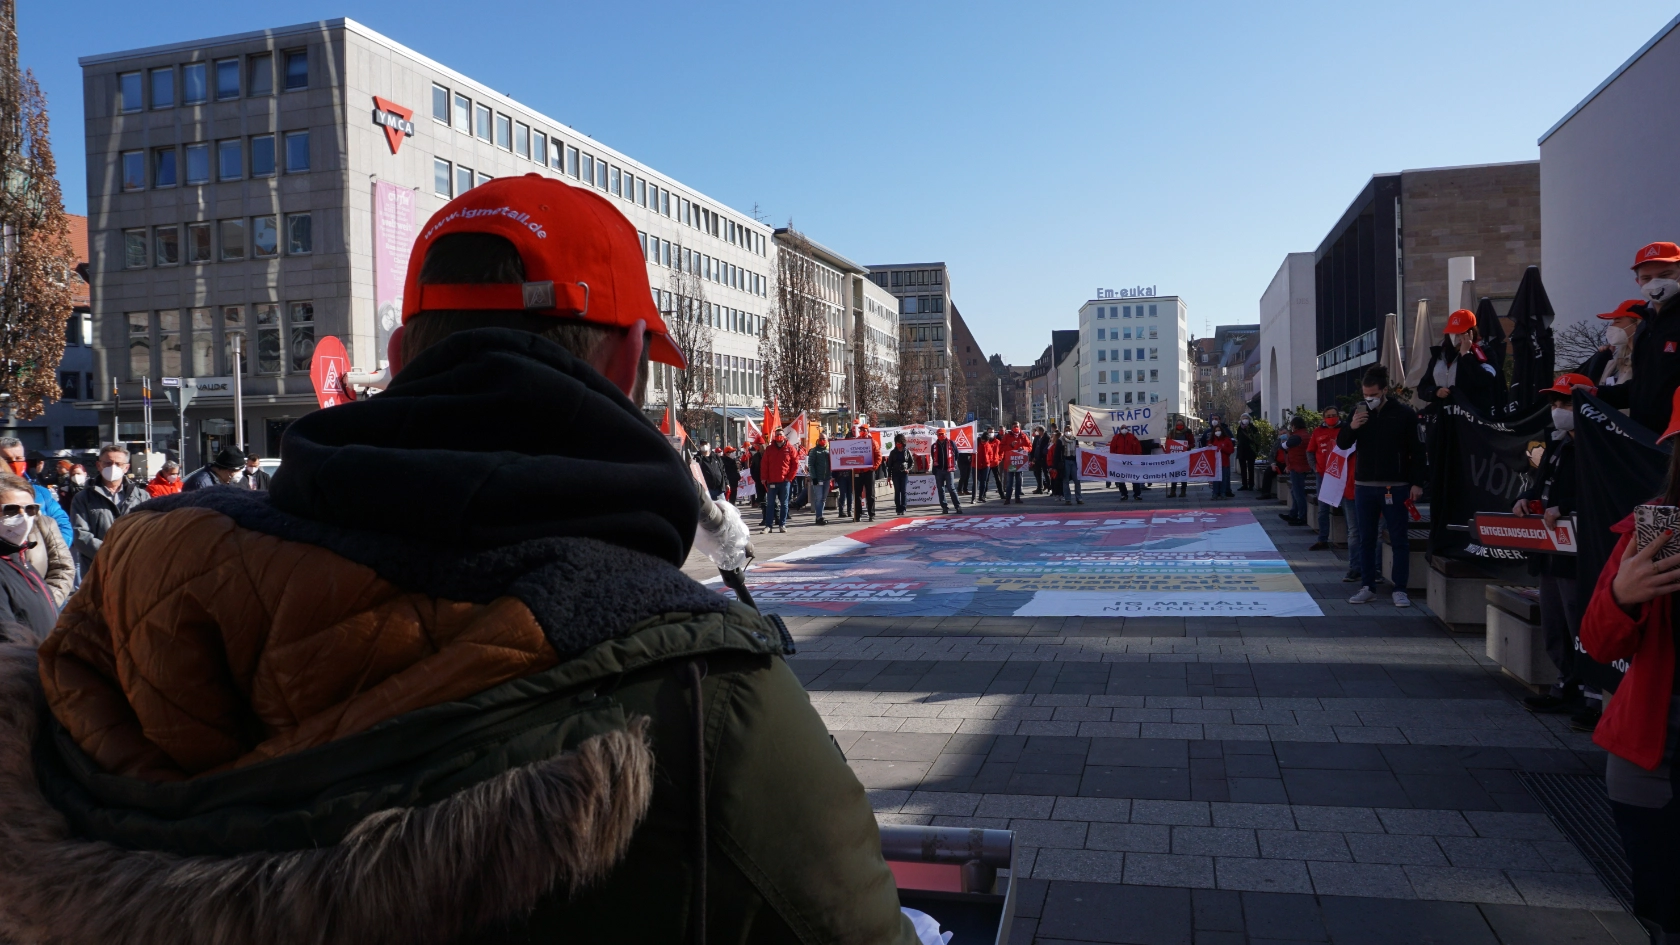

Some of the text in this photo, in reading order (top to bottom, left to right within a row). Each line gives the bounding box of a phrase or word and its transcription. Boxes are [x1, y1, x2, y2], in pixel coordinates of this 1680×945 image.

[379, 111, 412, 134] YMCA
[424, 206, 547, 239] www.igmetall.de
[1097, 285, 1156, 299] Em-eukal
[1108, 408, 1151, 422] TRAFO
[1109, 471, 1139, 480] Mobility
[1142, 471, 1167, 479] GmbH
[1480, 525, 1547, 540] ENTGELTAUSGLEICH
